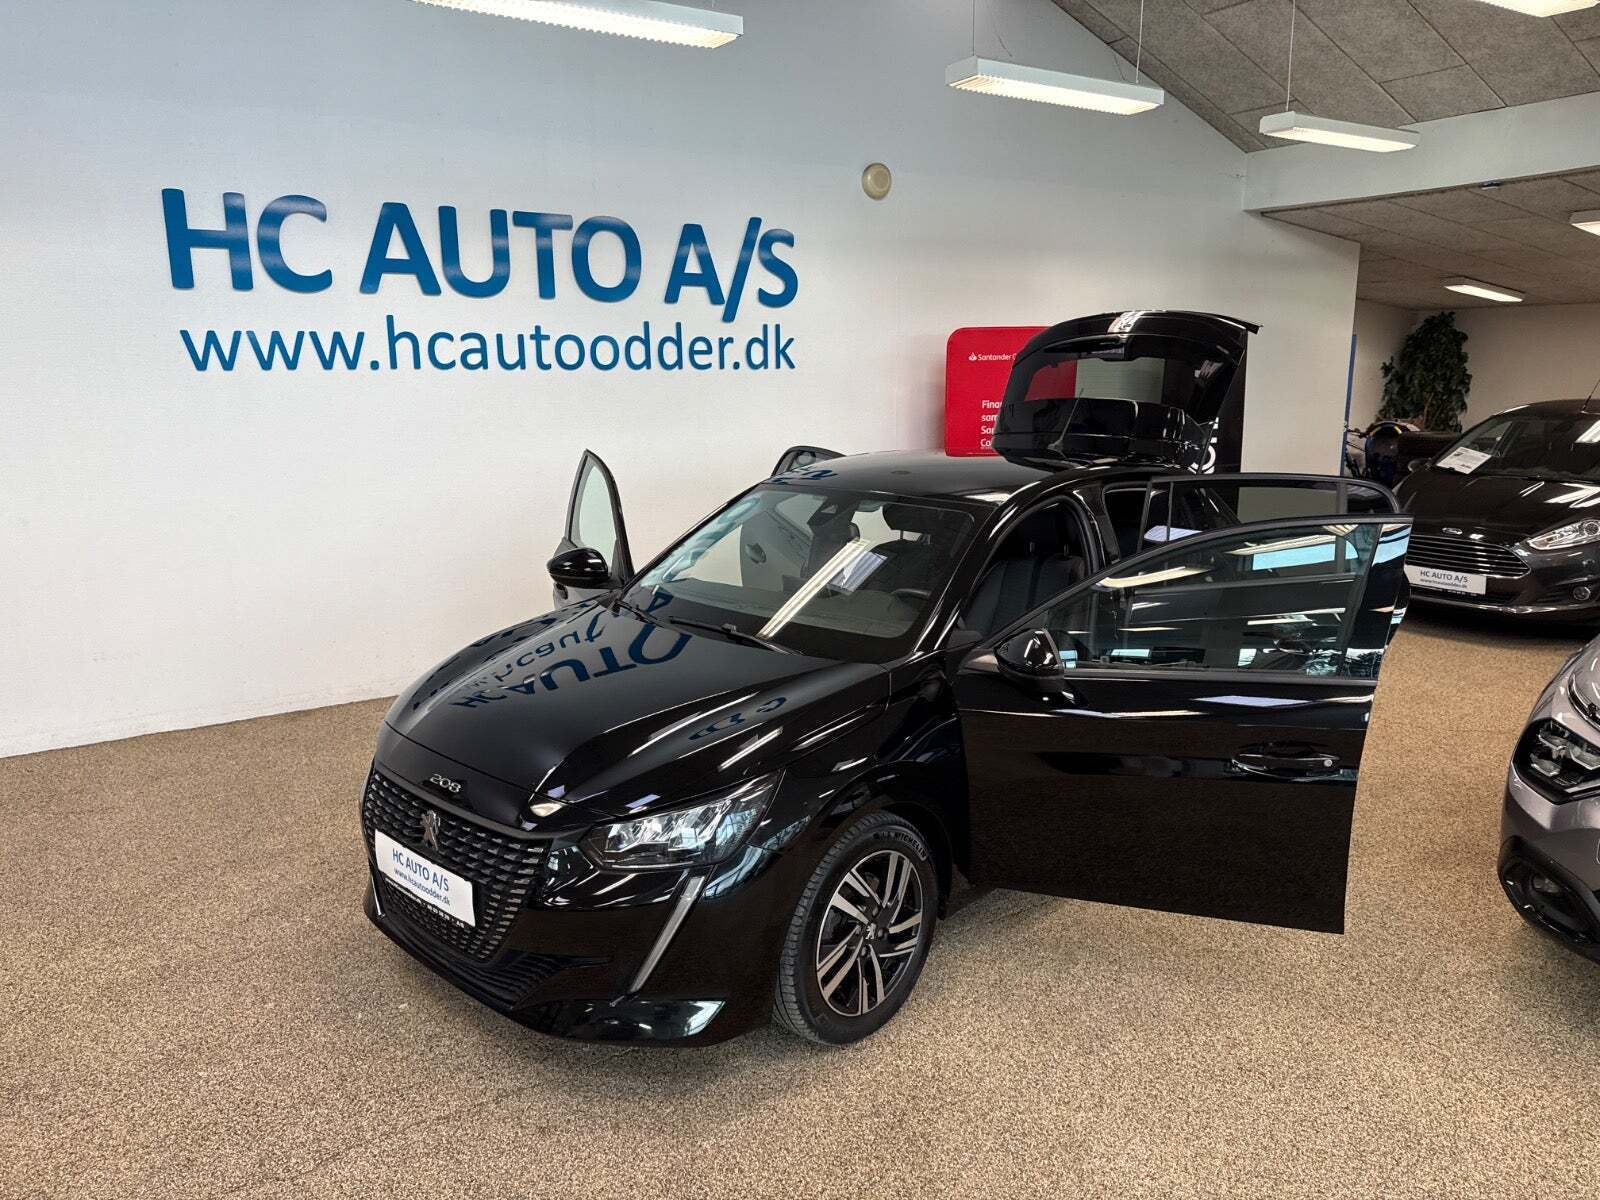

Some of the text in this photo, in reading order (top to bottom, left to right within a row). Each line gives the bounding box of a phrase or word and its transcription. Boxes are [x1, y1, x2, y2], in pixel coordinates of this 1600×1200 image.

[161, 188, 799, 324] HC AUTO A/S
[179, 314, 796, 372] www.hcautoodder.dk
[977, 353, 1012, 361] Santander
[1420, 570, 1468, 584] HC AUTO A/S
[429, 773, 462, 794] 208
[392, 848, 450, 892] HC AUTO A/S
